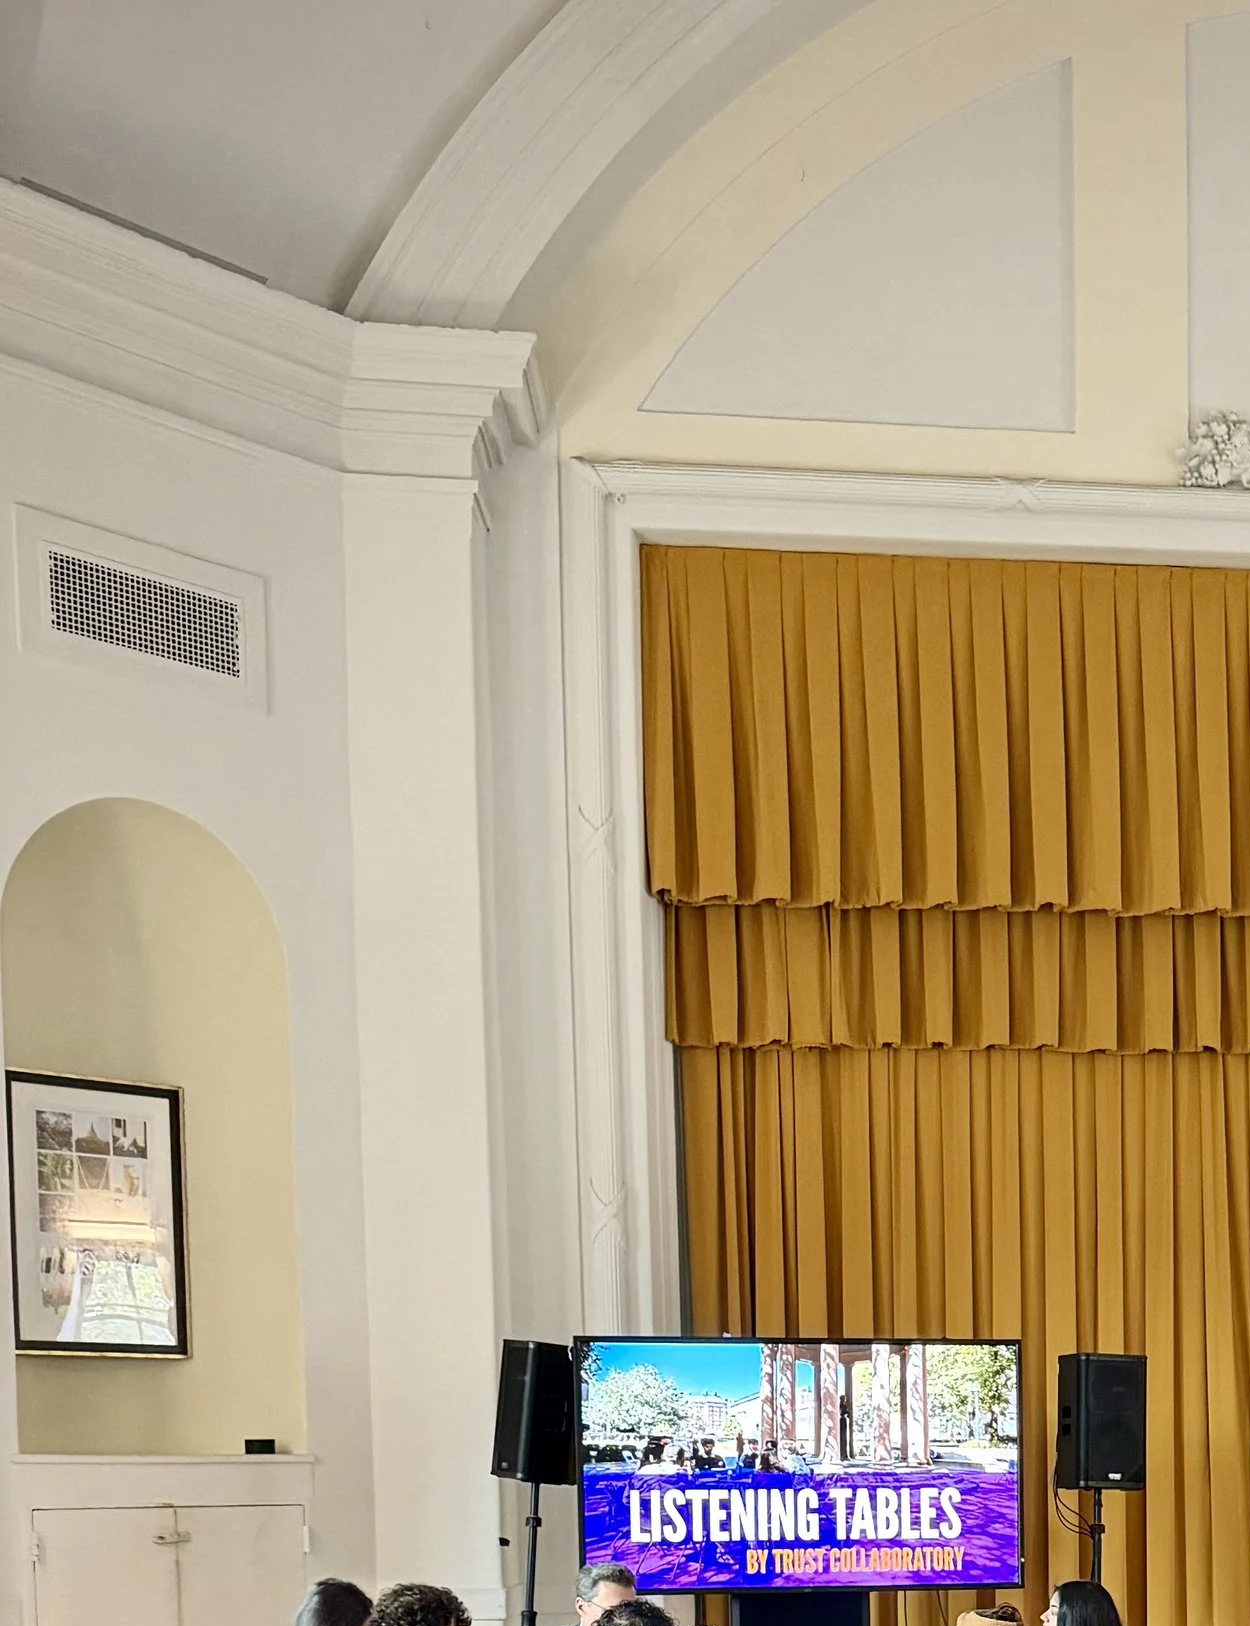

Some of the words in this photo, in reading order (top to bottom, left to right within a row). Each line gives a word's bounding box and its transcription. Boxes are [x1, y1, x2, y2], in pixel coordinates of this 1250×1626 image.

[629, 1487, 820, 1544] LISTENING
[829, 1487, 963, 1541] TABLES
[746, 1548, 766, 1575] BY
[772, 1548, 824, 1574] TRUST
[829, 1545, 965, 1573] COLLABORATORY
